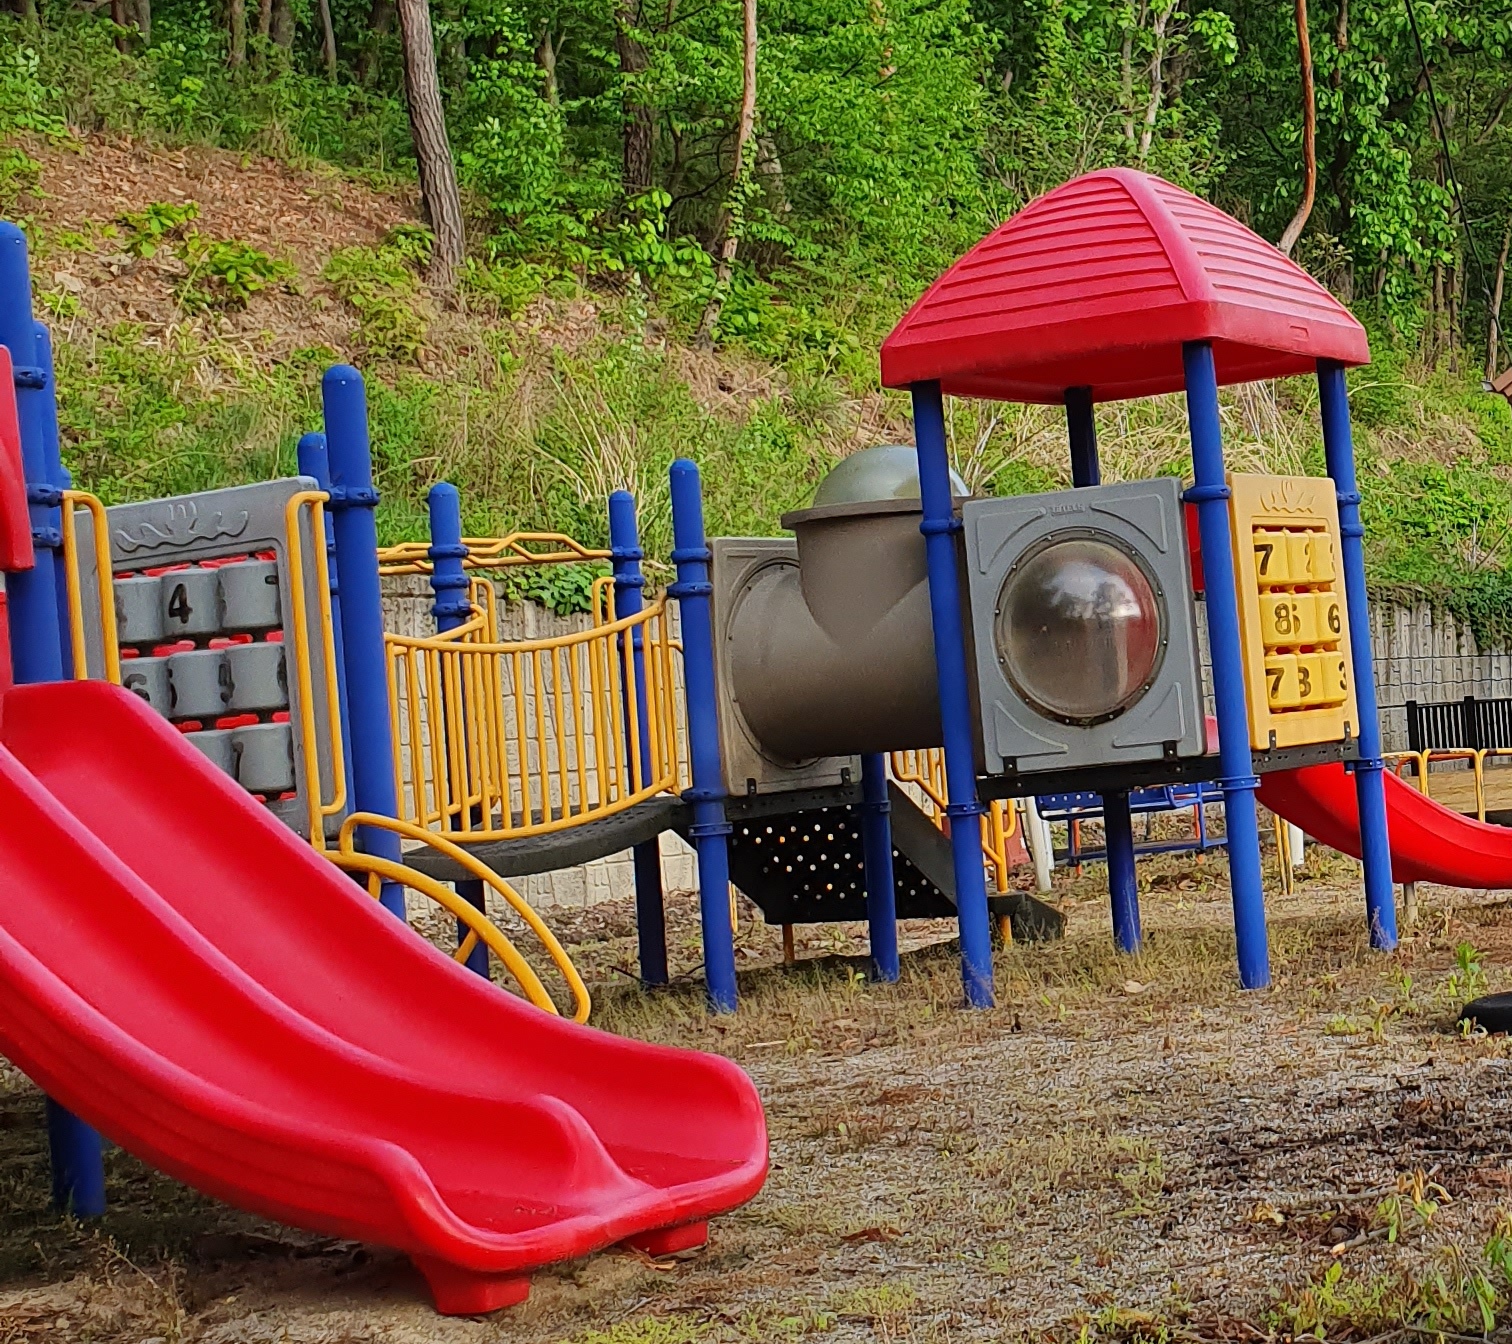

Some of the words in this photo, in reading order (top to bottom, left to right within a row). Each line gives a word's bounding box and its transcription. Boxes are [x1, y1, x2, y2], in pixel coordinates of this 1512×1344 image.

[1254, 543, 1273, 575] 7
[169, 583, 193, 624] 4
[1275, 603, 1291, 635] 8
[1328, 603, 1341, 634] 6
[1265, 667, 1284, 700] 7
